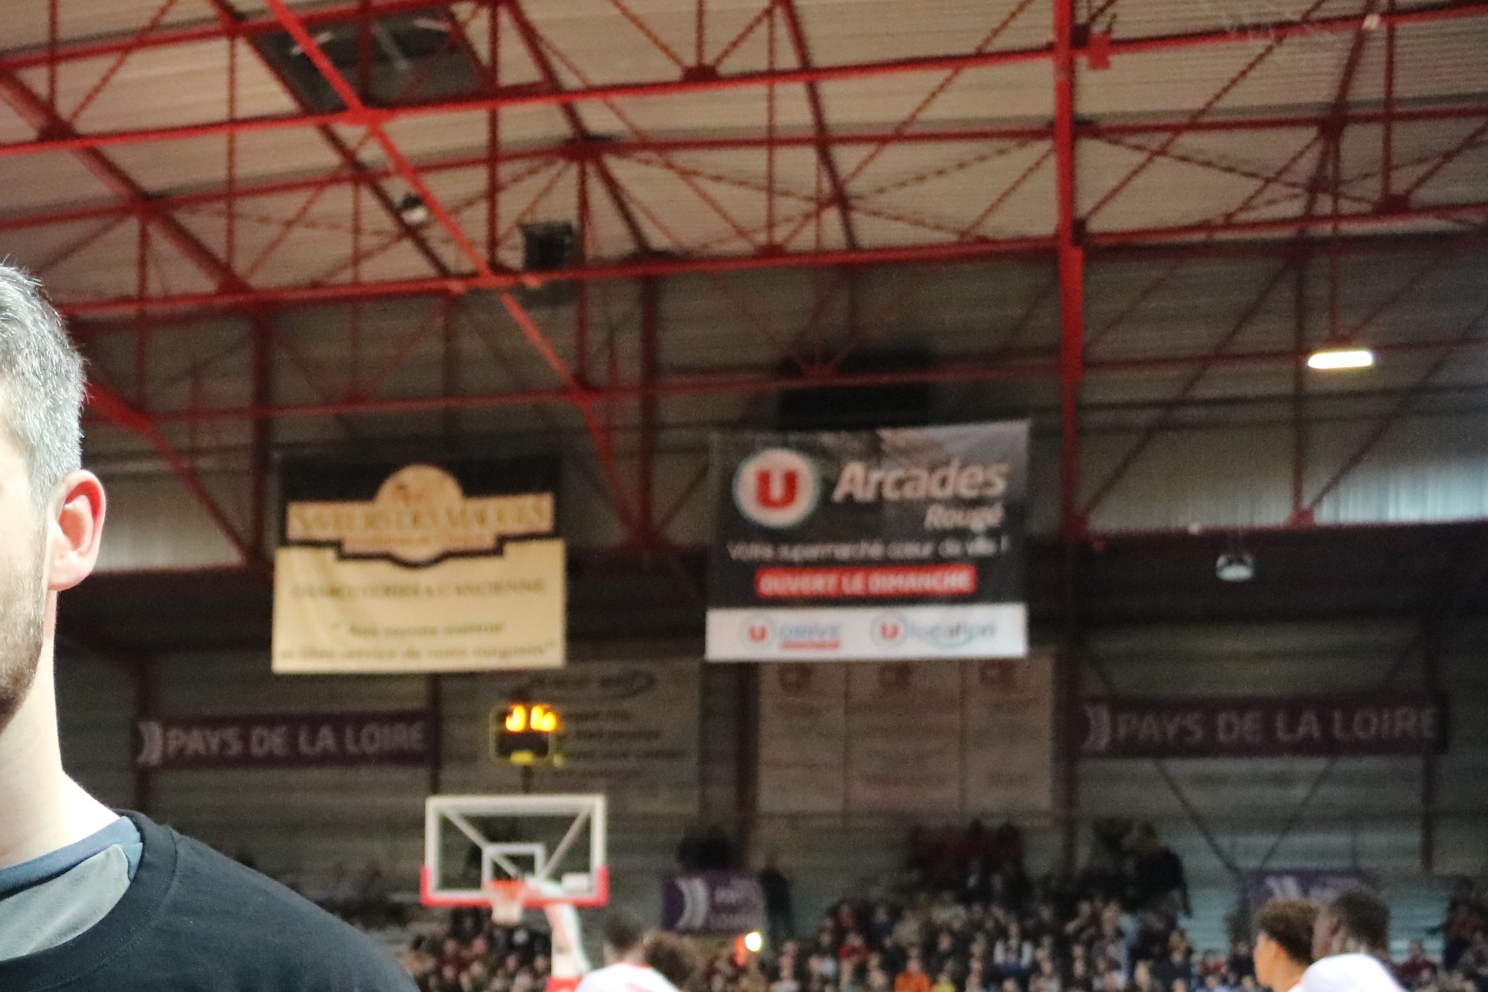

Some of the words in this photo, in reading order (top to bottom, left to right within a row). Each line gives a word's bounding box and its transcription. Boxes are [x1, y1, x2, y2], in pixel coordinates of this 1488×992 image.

[754, 467, 799, 512] U
[830, 458, 1010, 503] Arcades
[165, 727, 243, 758] PAYS
[250, 726, 288, 757] DE
[298, 723, 336, 755] LA
[344, 720, 426, 754] LOIRE
[1115, 711, 1204, 745] PAYS
[1215, 709, 1264, 743] DE
[1275, 709, 1321, 742] LA
[1332, 706, 1438, 740] LOIRE
